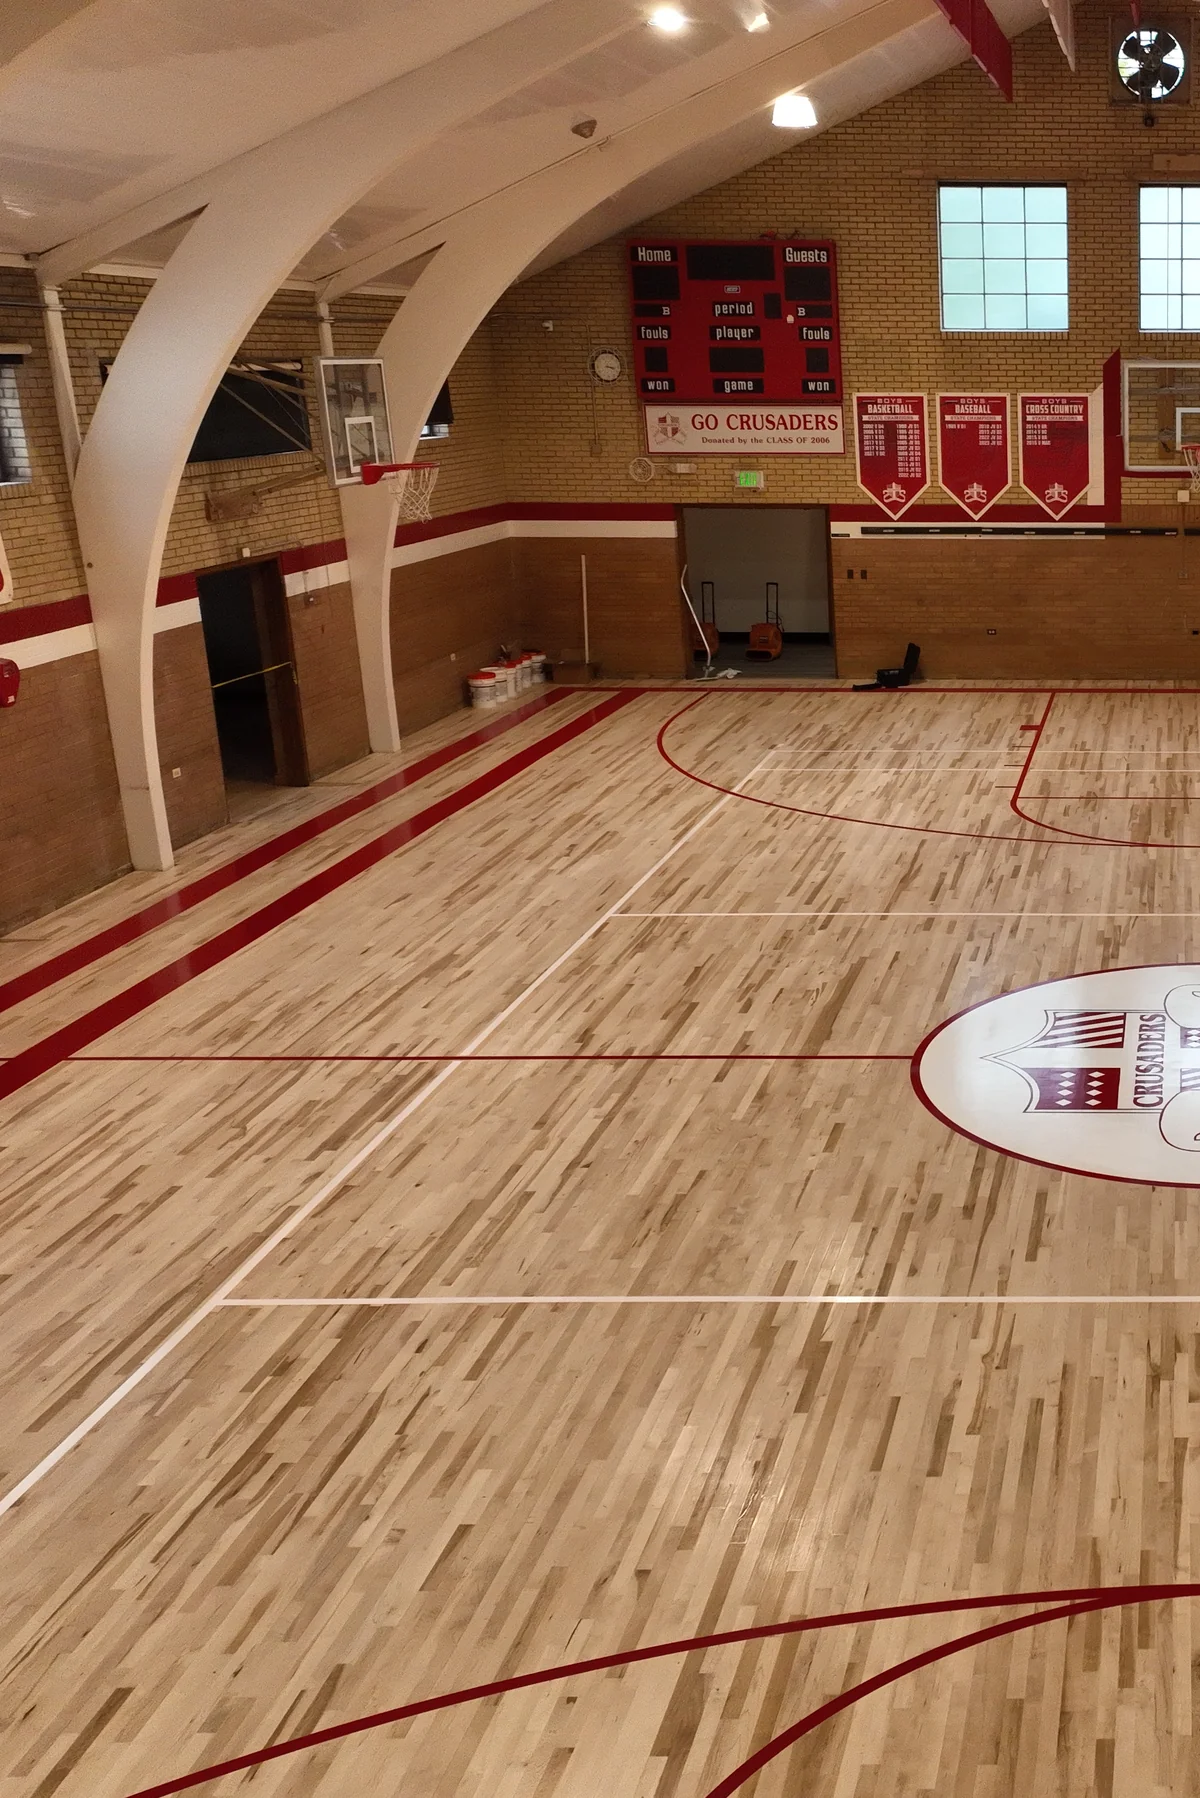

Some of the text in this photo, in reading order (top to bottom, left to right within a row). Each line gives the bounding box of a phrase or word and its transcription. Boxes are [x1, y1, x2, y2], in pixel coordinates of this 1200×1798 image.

[638, 247, 671, 262] Home
[785, 248, 827, 263] Guests
[662, 307, 670, 315] B
[715, 302, 753, 316] period
[798, 308, 805, 316] B
[641, 327, 668, 339] fouls
[716, 326, 754, 340] player
[803, 327, 830, 340] fouls
[647, 380, 669, 390] won
[724, 380, 753, 393] game
[808, 381, 829, 391] won
[867, 404, 913, 413] BASKETBALL
[955, 404, 991, 413] BASEBALL
[1026, 405, 1083, 414] CROSS COUNTRY
[692, 414, 718, 430] GO
[726, 414, 838, 430] CRUSADERS
[702, 436, 734, 444] Donated
[738, 436, 747, 445] by
[751, 436, 763, 444] the
[1133, 1014, 1166, 1107] CRUSADERS
